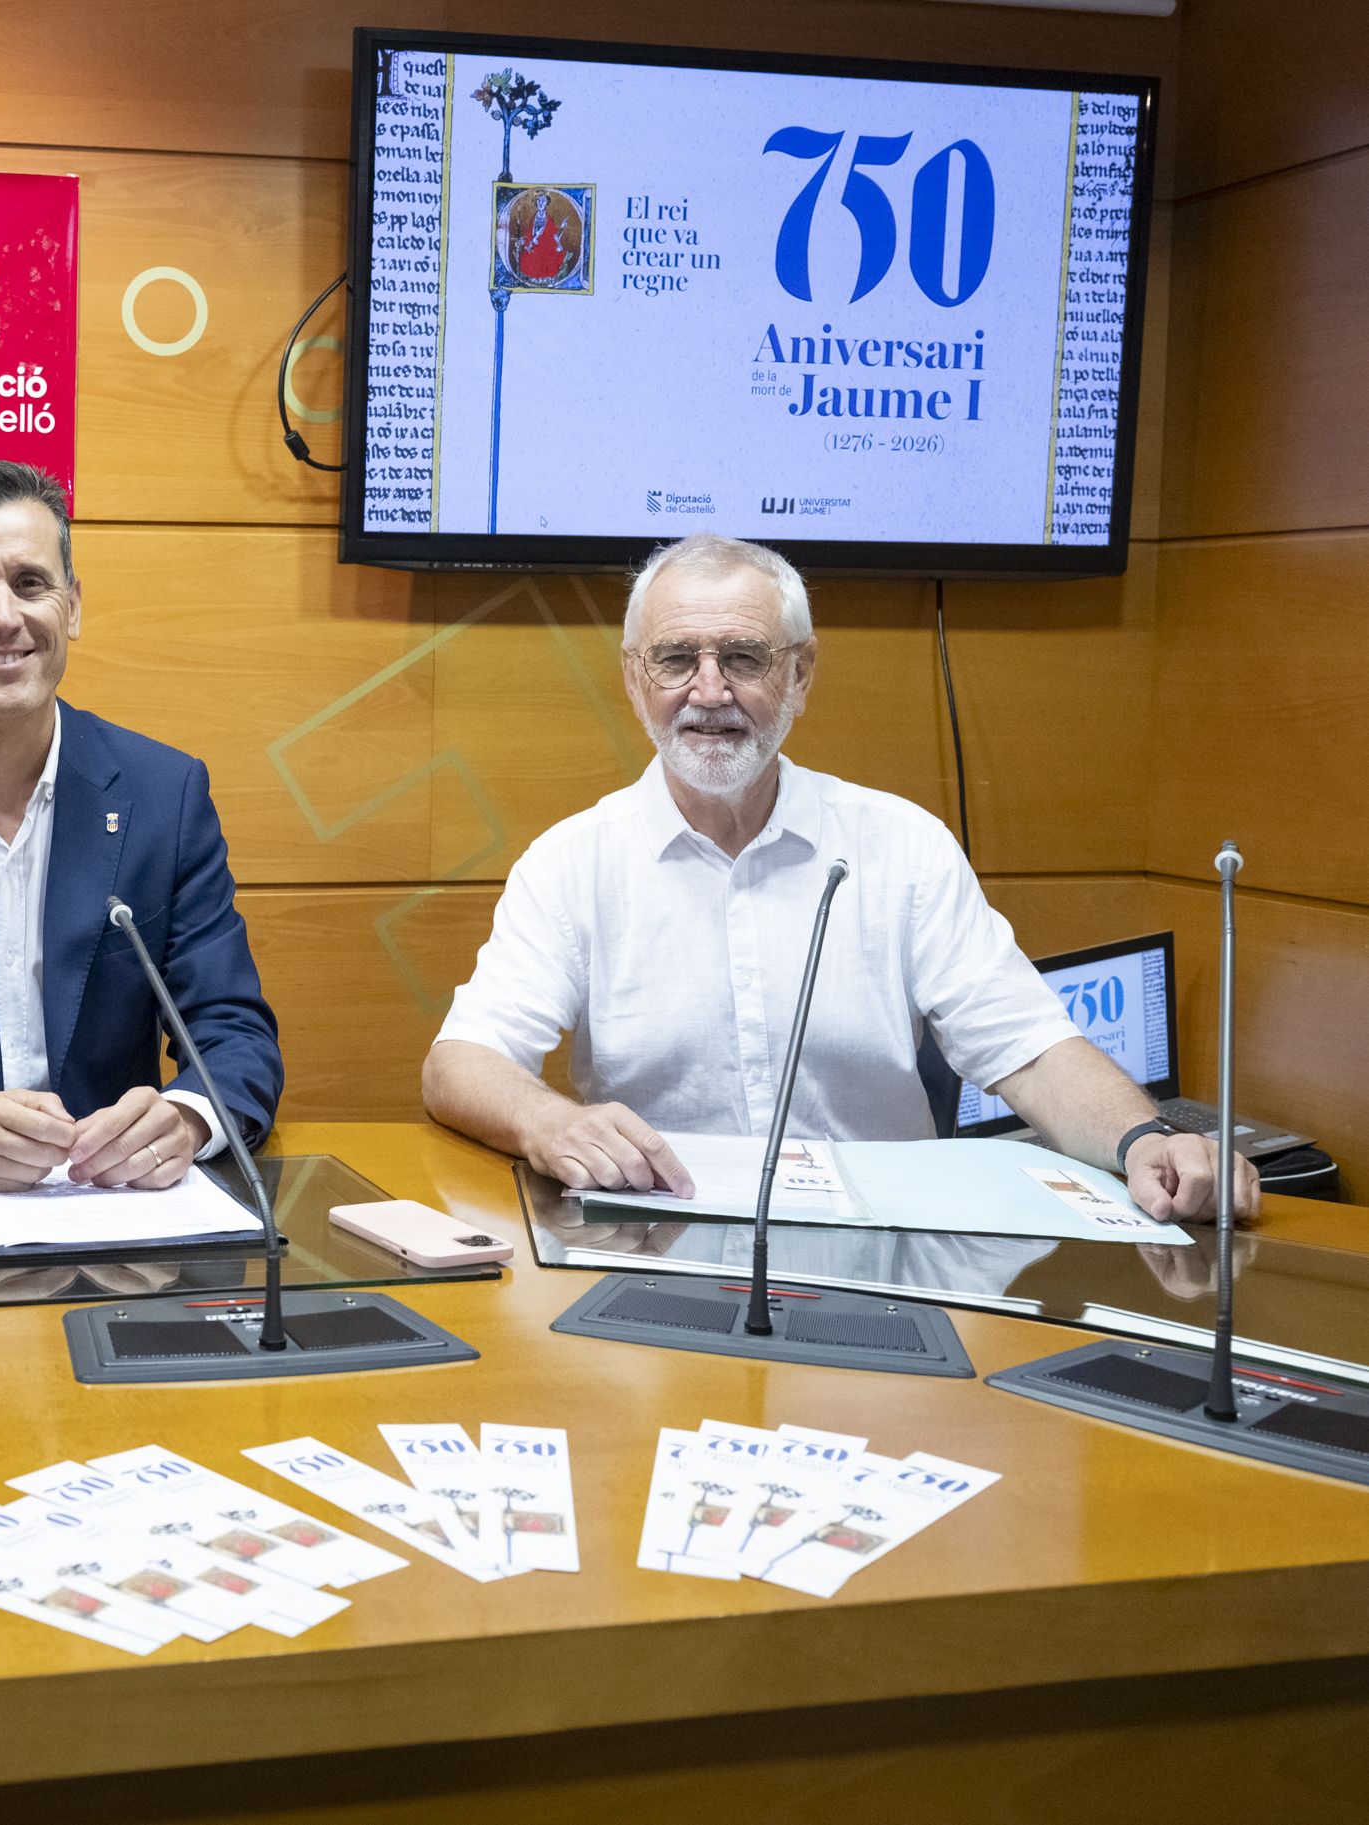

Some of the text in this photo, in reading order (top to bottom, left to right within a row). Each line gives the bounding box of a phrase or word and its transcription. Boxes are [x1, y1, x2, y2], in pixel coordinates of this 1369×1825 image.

[625, 196, 688, 221] El rei
[762, 126, 995, 308] 750
[623, 226, 700, 249] que va
[622, 250, 721, 270] crear un
[622, 273, 689, 297] regne
[752, 323, 986, 370] Aniversari
[751, 369, 777, 382] de la
[751, 384, 792, 397] mort de
[788, 373, 986, 421] Jaume I
[823, 431, 874, 454] (1276
[890, 433, 946, 456] 2026)
[665, 504, 716, 515] de Castelló
[666, 493, 712, 506] Diputació
[761, 497, 795, 514] UJI
[798, 506, 827, 515] JAUME
[799, 498, 851, 508] UNIVERSITAT
[1059, 975, 1124, 1028] 750
[398, 1439, 466, 1455] 750
[492, 1438, 557, 1457] 750
[783, 1438, 849, 1462] 750
[121, 1461, 192, 1484] 750
[274, 1453, 345, 1475] 750
[898, 1465, 970, 1493] 750
